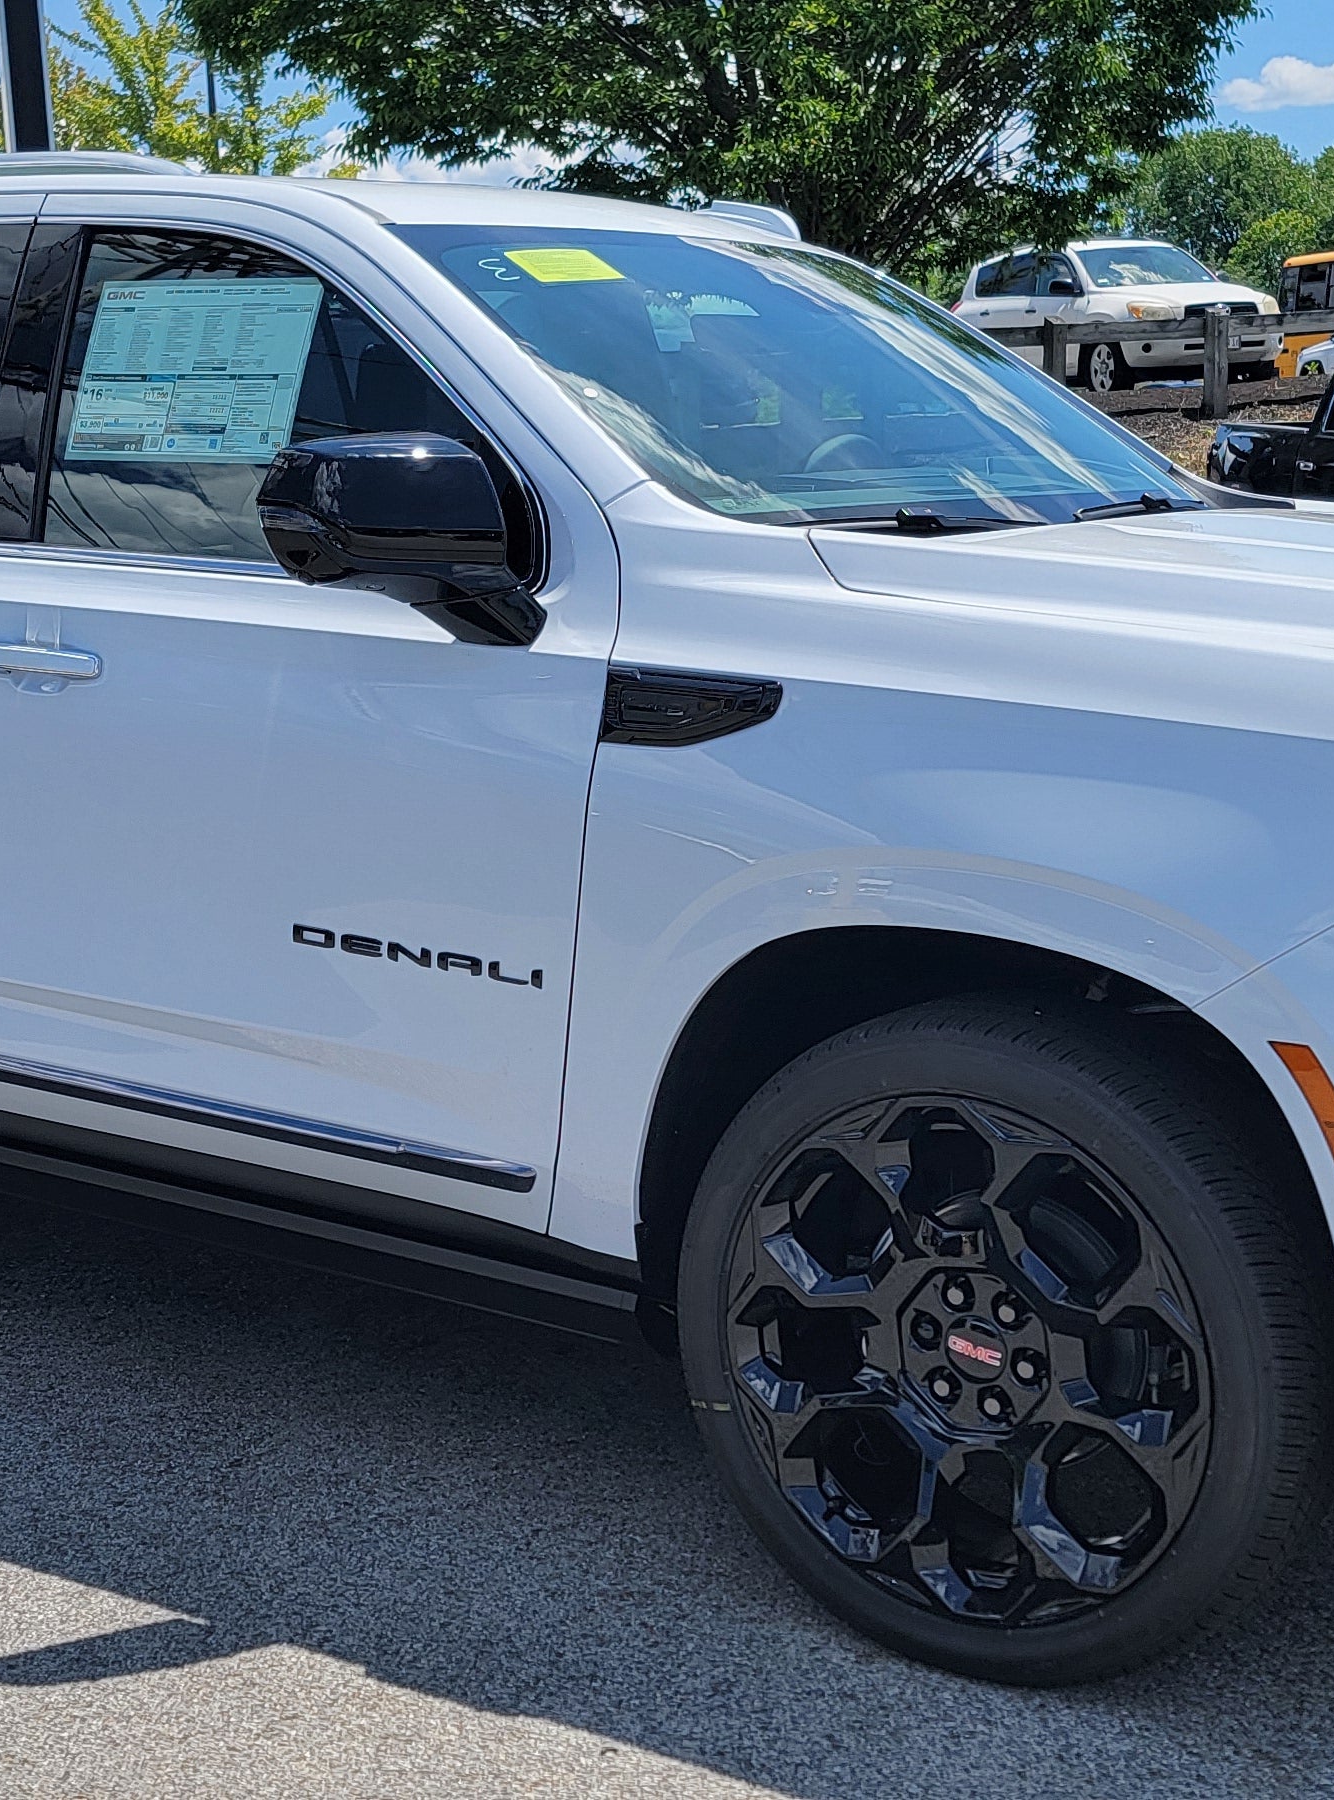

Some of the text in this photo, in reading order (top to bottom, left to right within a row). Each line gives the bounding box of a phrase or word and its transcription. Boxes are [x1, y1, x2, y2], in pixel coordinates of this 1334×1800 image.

[107, 291, 146, 300] GMC
[89, 388, 104, 401] 16
[292, 922, 543, 990] DENALI
[948, 1335, 1001, 1366] GMC
